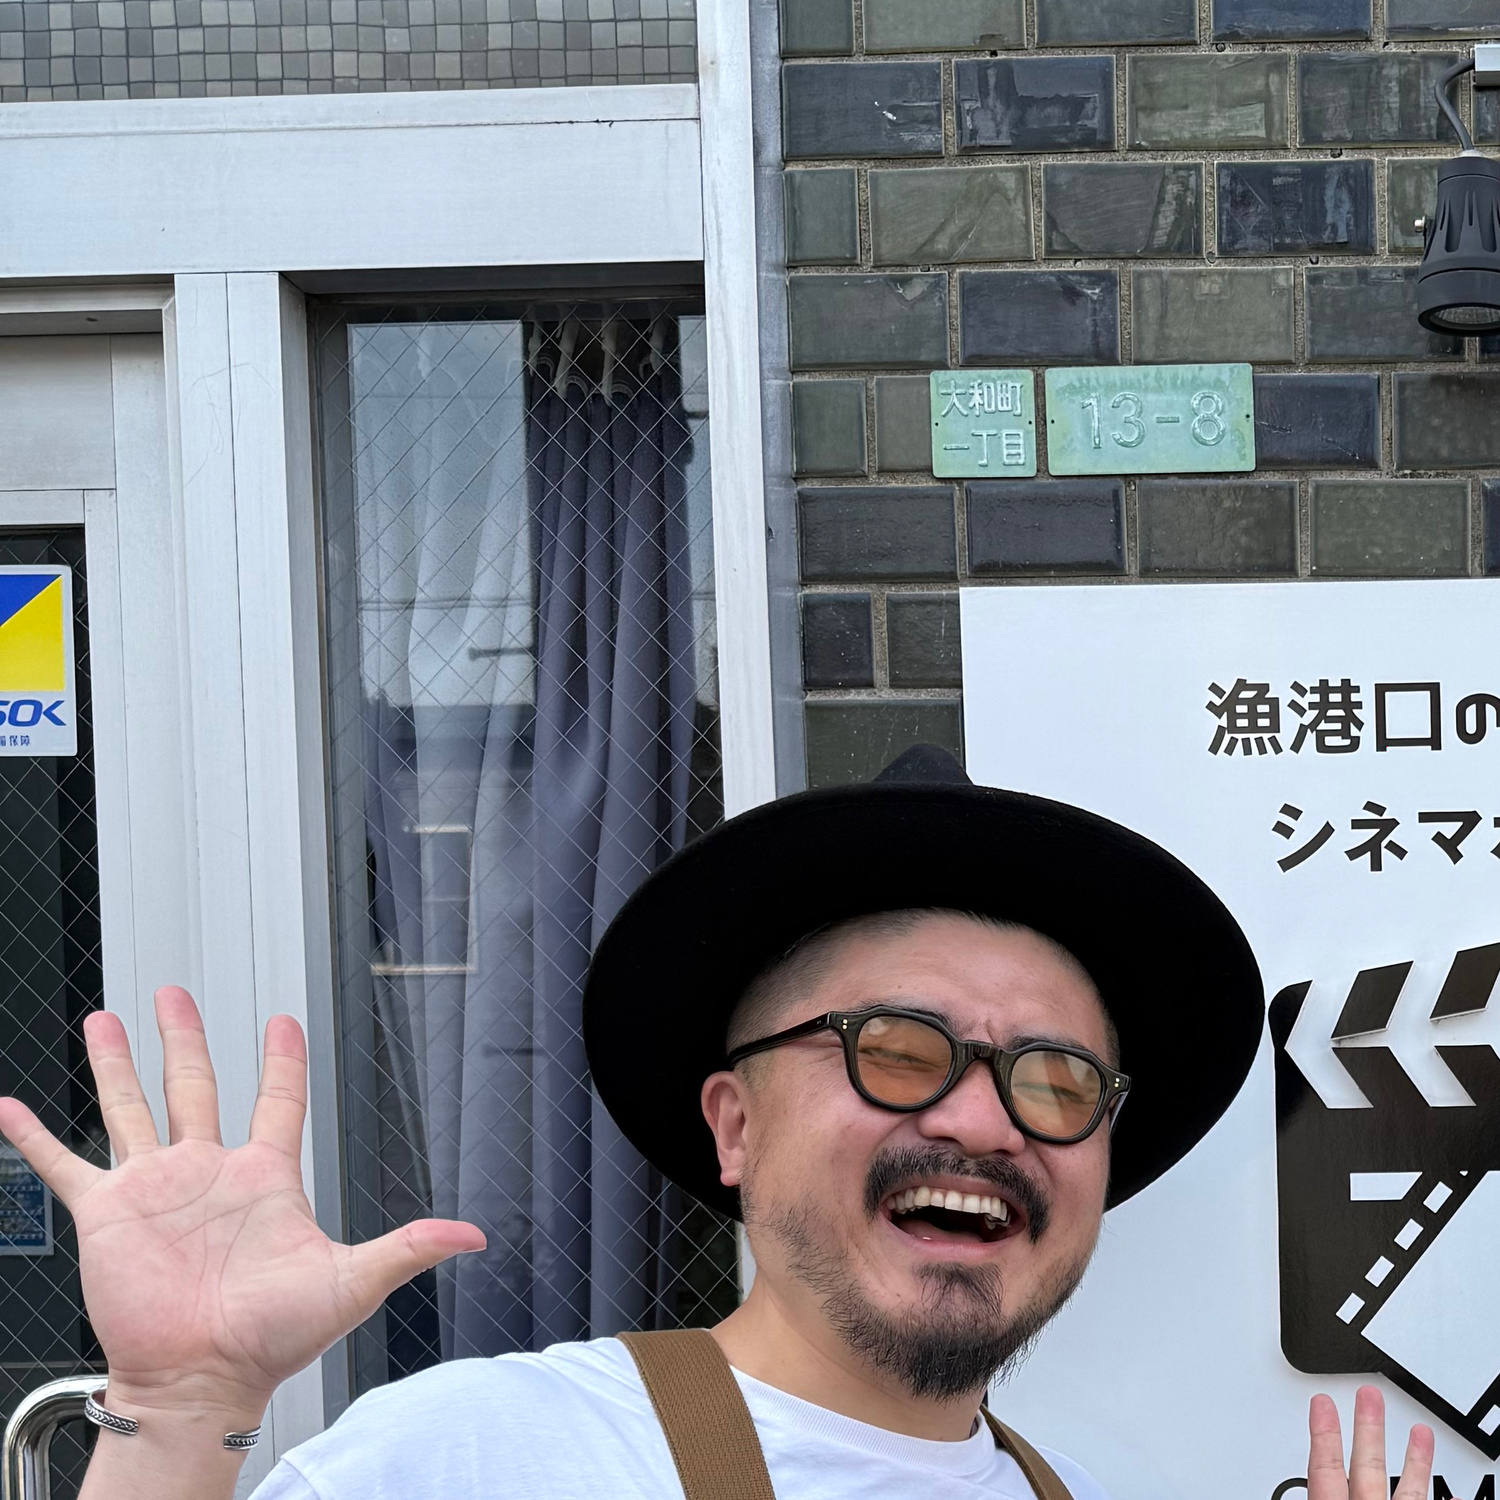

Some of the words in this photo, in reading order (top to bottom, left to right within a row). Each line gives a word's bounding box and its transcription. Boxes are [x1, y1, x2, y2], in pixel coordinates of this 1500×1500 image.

[940, 379, 1024, 418] 大和町
[1082, 390, 1228, 450] 13-8
[943, 428, 1026, 468] 一丁目
